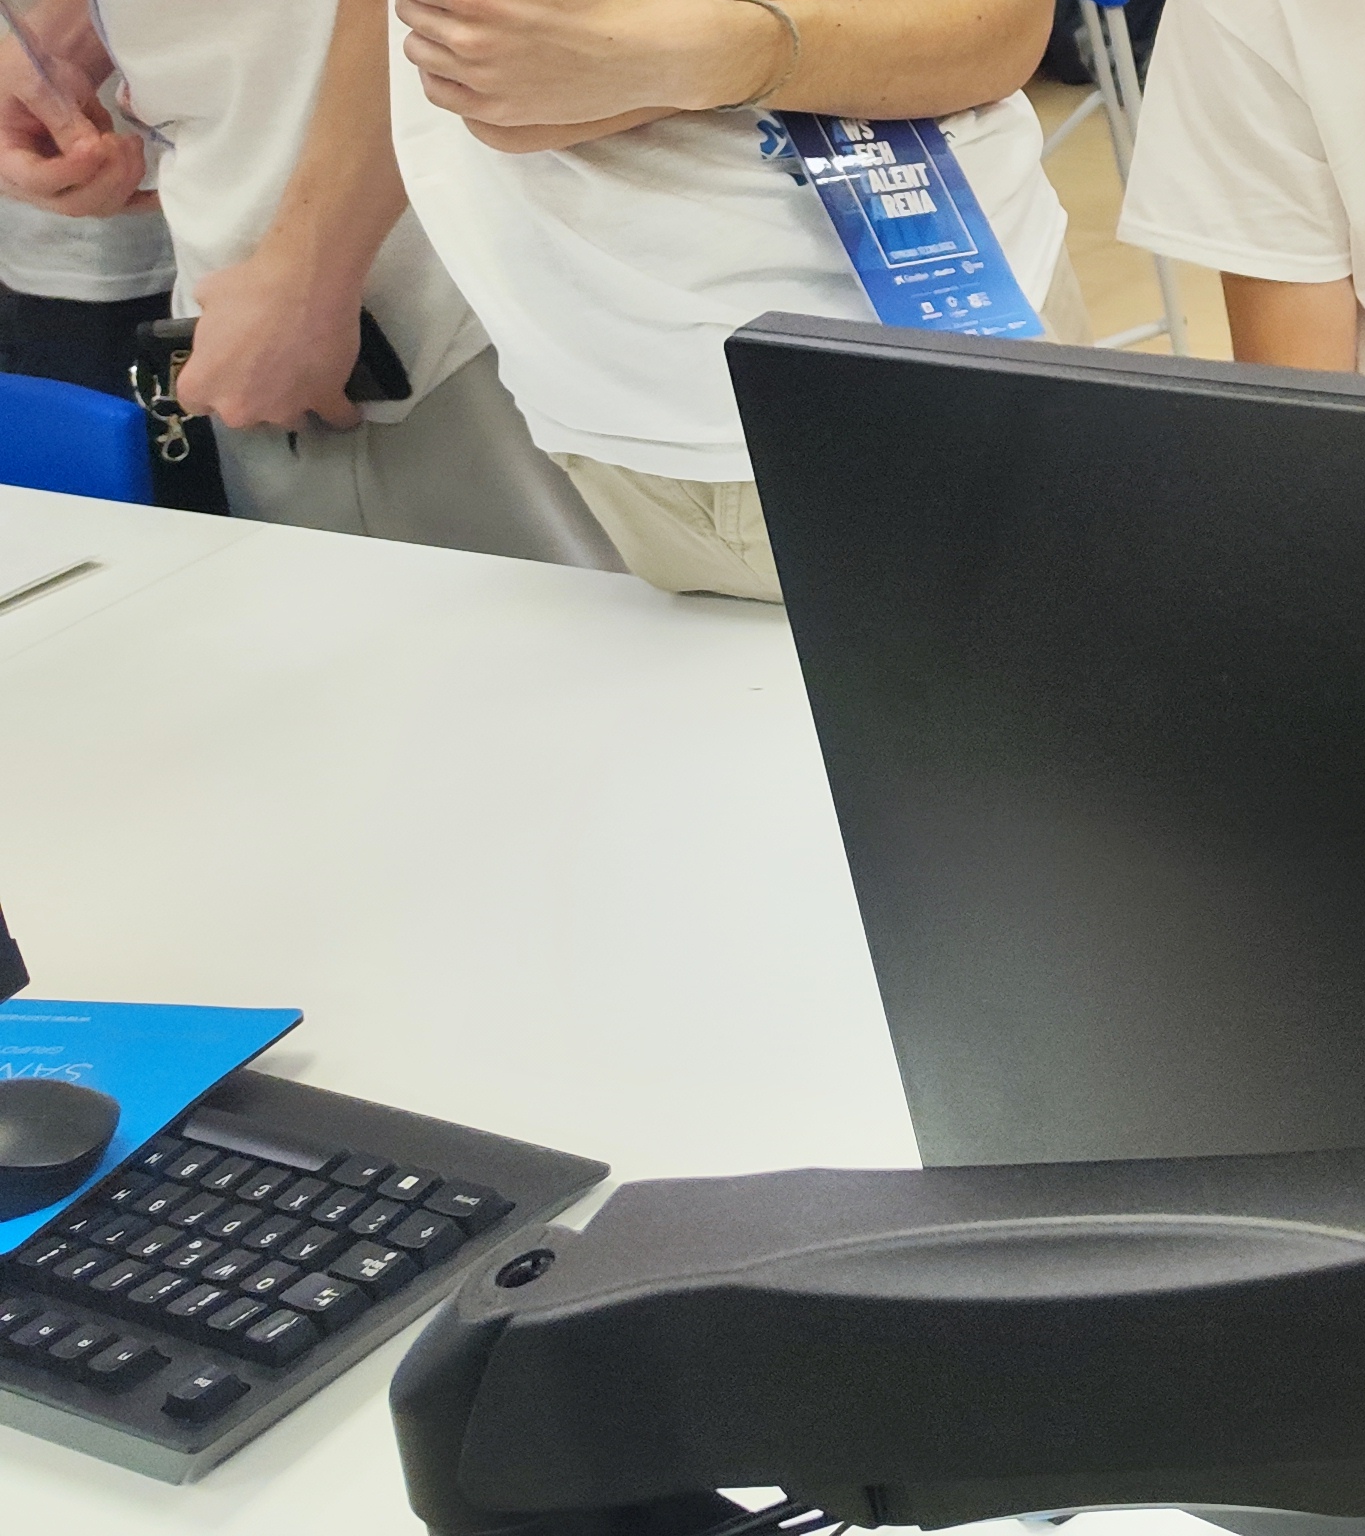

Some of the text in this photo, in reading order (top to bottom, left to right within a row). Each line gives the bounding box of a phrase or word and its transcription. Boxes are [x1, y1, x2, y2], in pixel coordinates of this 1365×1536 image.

[832, 119, 875, 144] AWS
[860, 162, 931, 194] TALENT
[870, 189, 938, 220] ARENA
